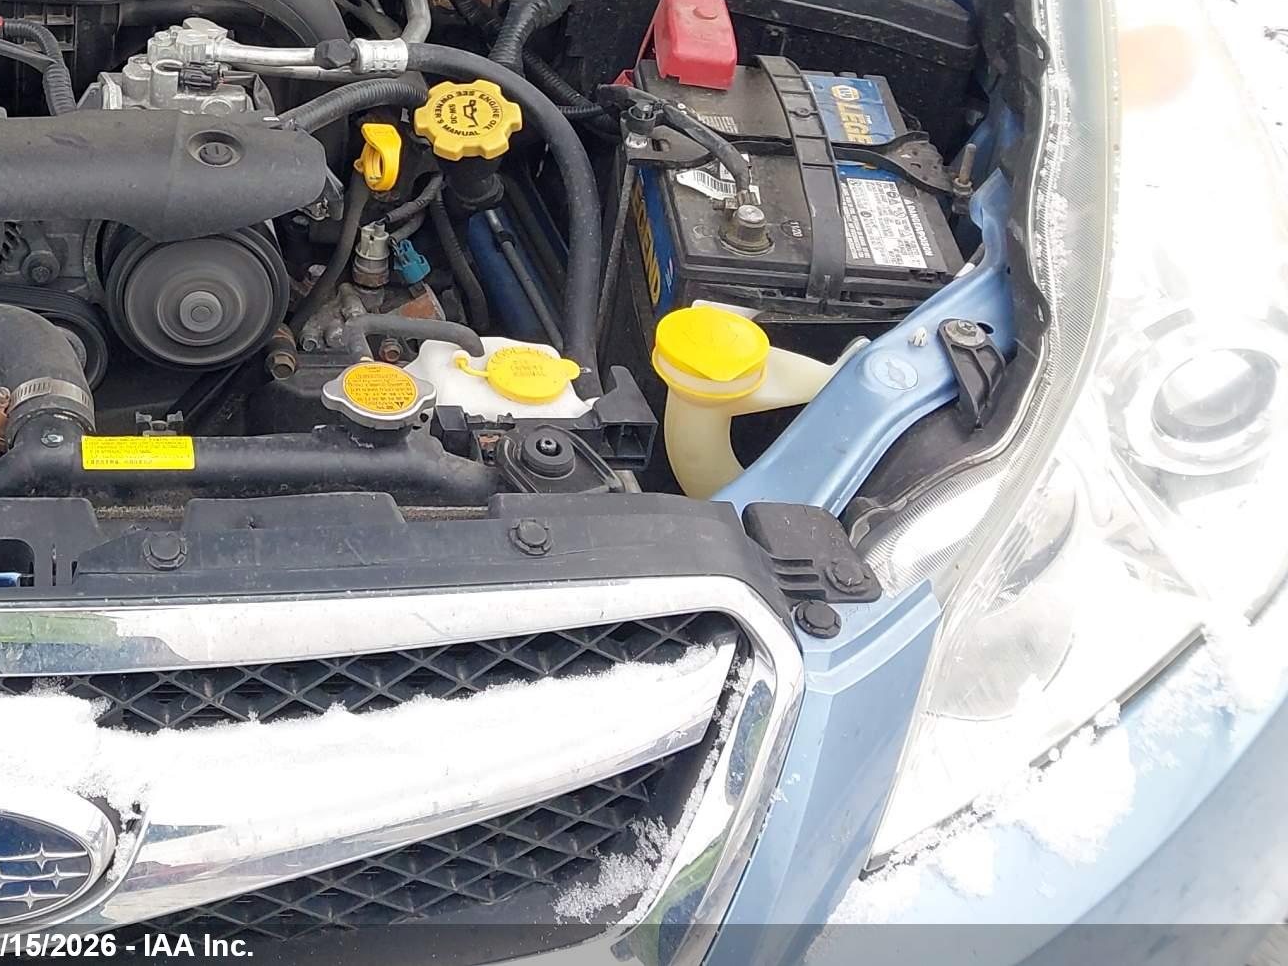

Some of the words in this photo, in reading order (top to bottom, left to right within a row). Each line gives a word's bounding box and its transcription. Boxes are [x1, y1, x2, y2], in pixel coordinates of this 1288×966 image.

[478, 93, 500, 118] ENGINE
[441, 124, 481, 137] MANUAL
[483, 120, 497, 131] OIL
[836, 102, 873, 145] LEGE
